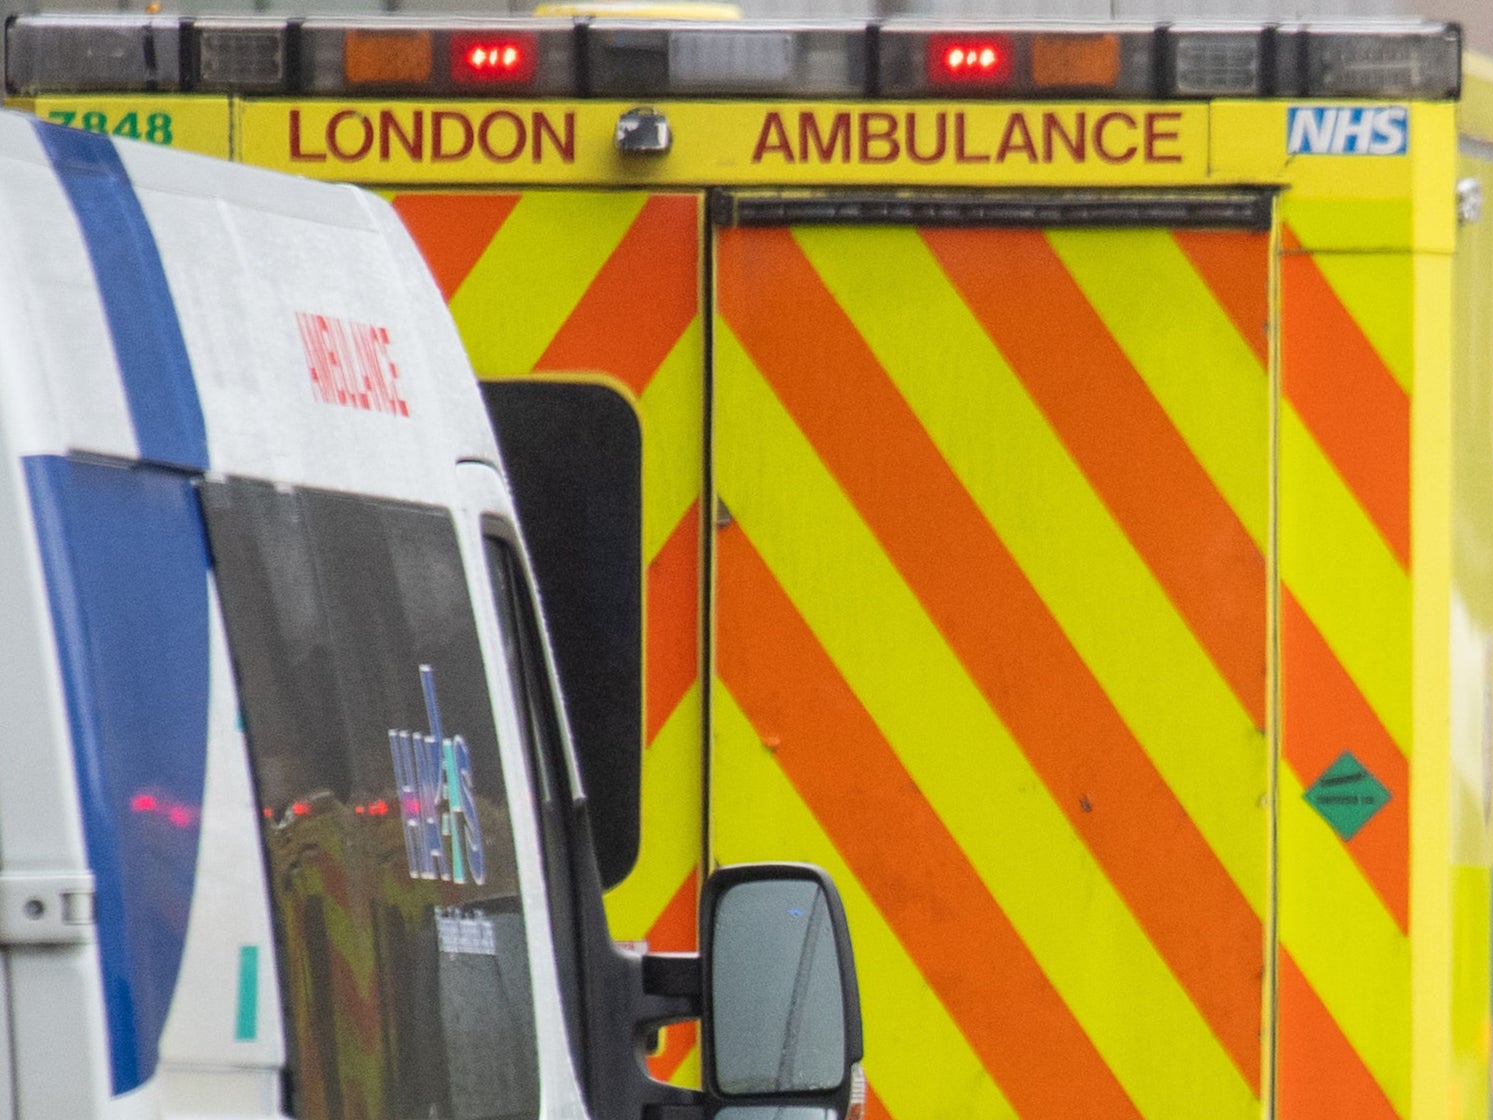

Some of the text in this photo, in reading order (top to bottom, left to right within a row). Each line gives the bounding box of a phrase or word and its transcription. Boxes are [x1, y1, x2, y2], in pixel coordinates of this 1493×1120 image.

[289, 110, 1184, 164] LONDON AMBULANCE
[1287, 106, 1405, 155] NHS
